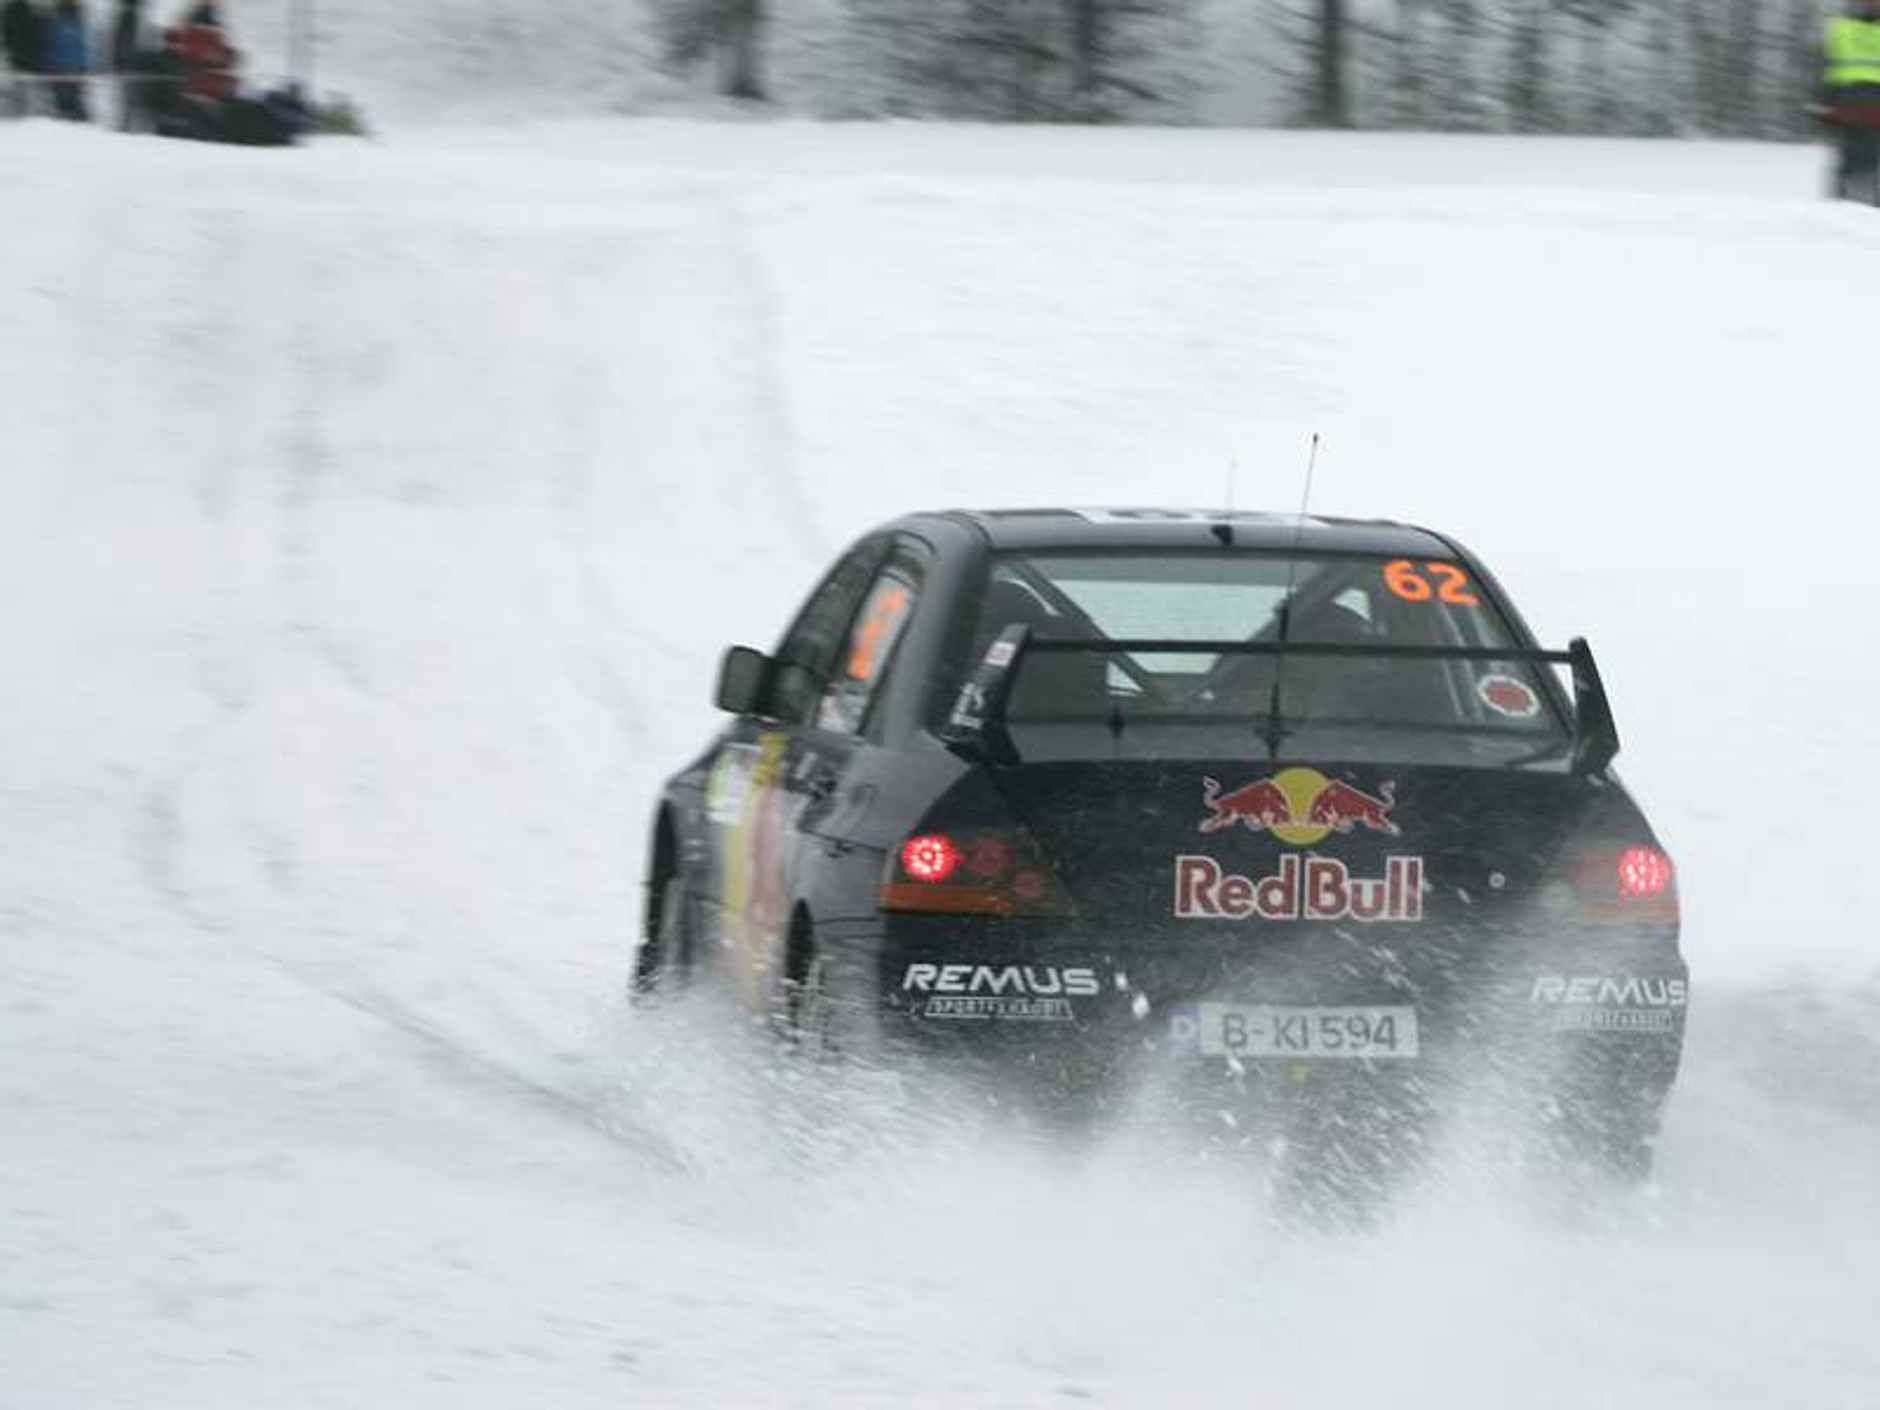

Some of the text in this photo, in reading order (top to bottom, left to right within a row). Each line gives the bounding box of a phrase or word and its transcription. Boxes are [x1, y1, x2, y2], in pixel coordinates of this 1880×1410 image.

[1383, 559, 1481, 604] 62
[1174, 853, 1423, 921] Red Bull
[902, 963, 1100, 995] REMUS
[1530, 976, 1687, 1007] REMUS
[1318, 1015, 1397, 1050] 594
